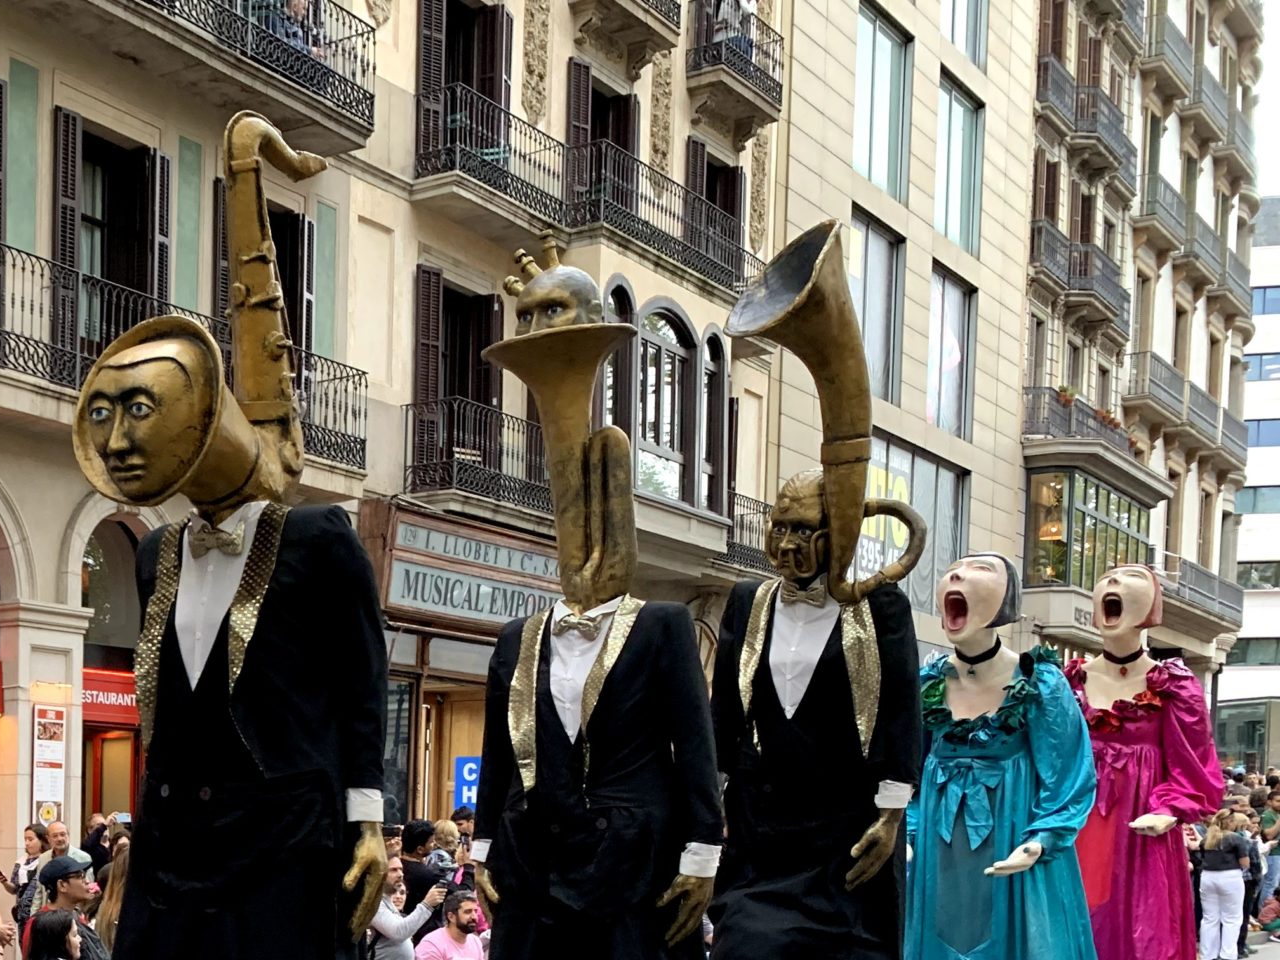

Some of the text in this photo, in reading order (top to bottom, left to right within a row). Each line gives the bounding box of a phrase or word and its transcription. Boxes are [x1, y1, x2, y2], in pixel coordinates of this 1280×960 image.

[443, 534, 500, 565] LLOBET
[507, 550, 514, 568] Y
[400, 568, 484, 613] MUSICAL
[81, 690, 137, 707] ESTAURANT
